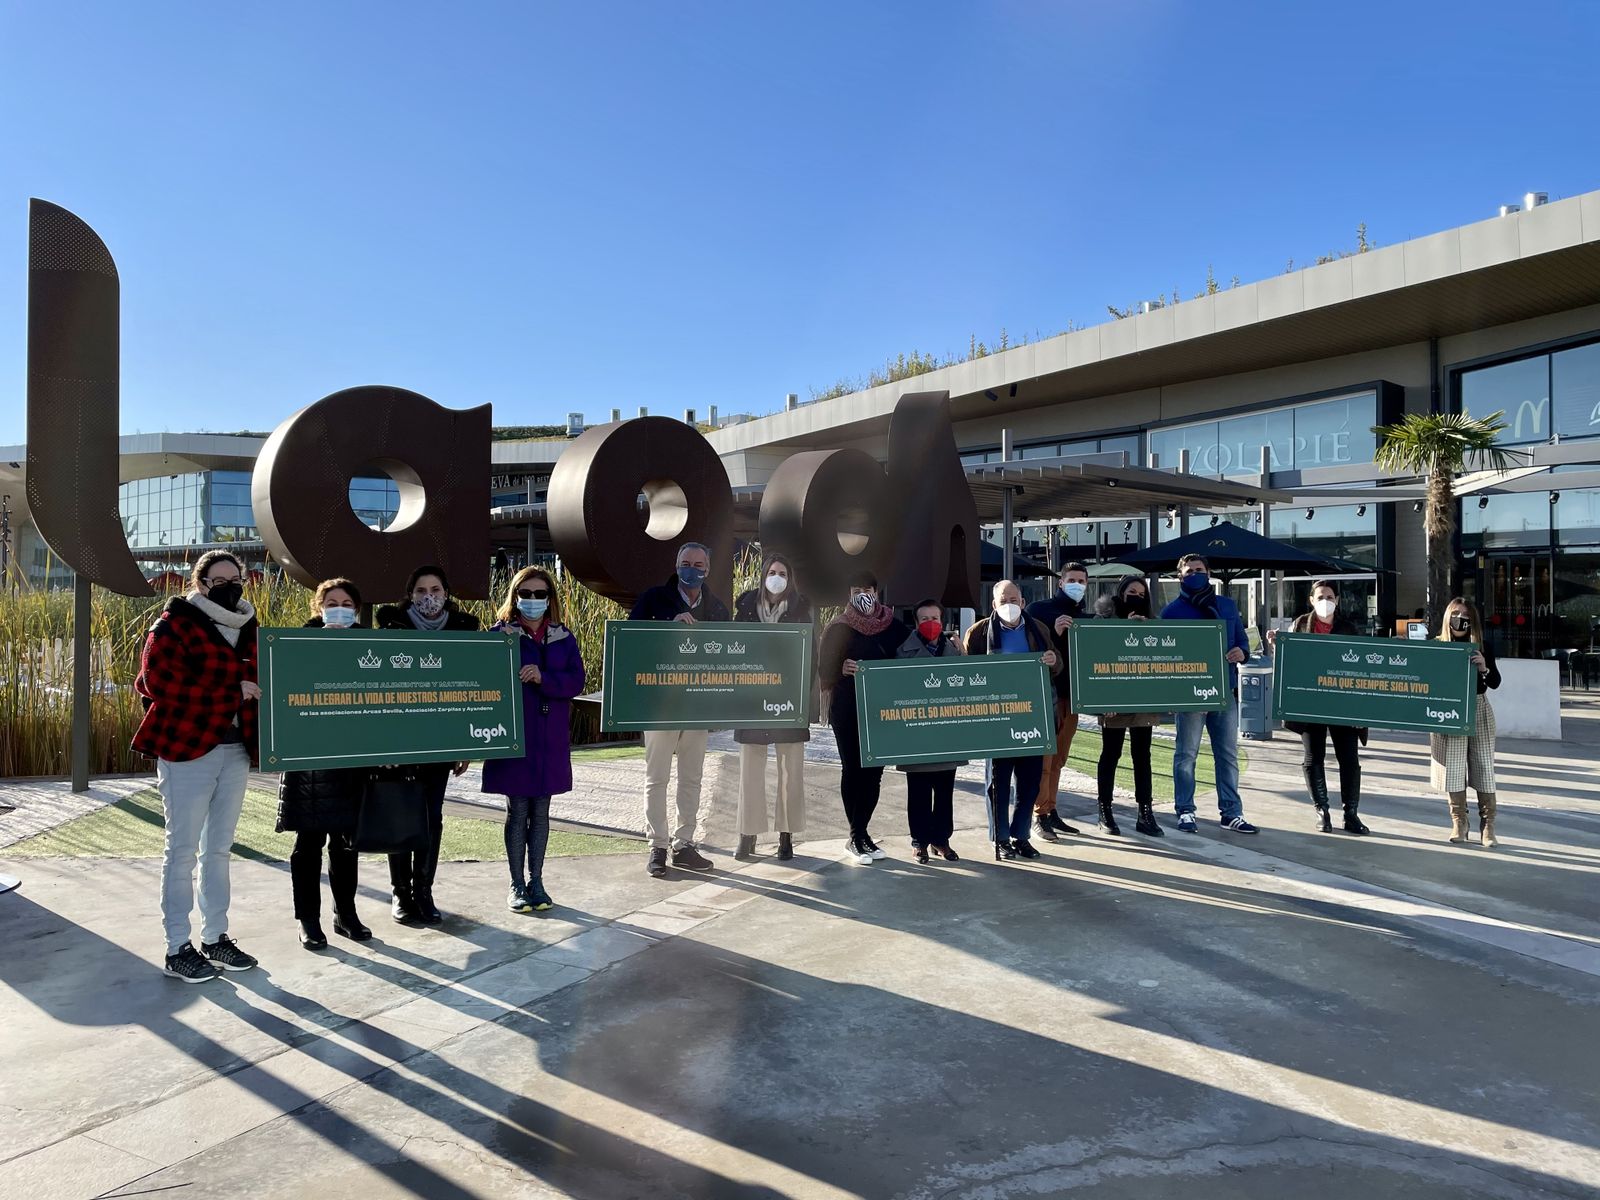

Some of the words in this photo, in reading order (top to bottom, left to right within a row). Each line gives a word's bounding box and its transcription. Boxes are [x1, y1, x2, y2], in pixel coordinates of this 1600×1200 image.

[1179, 420, 1352, 474] VOLAPIÉ
[1094, 663, 1110, 673] PARA
[1111, 663, 1128, 673] TODO
[1129, 663, 1136, 673] LO
[1138, 663, 1150, 675] QUE
[1151, 663, 1174, 673] PUEDAN
[1175, 663, 1207, 672] NECESITAR
[314, 681, 365, 689] DONACIÓN
[636, 673, 657, 685] PARA
[658, 673, 688, 685] LLENAR
[690, 673, 699, 685] LA
[701, 671, 733, 685] CÁMARA
[734, 671, 782, 684] FRIGORÍFICA
[1318, 676, 1337, 687] PARA
[1339, 678, 1354, 689] QUE
[1355, 678, 1389, 690] SIEMPRE
[1391, 681, 1408, 692] SIGA
[1410, 682, 1429, 694] VIVO
[288, 694, 311, 706] PARA
[313, 693, 352, 706] ALEGRAR
[353, 693, 363, 704] LA
[365, 692, 384, 704] VIDA
[385, 692, 396, 704] DE
[397, 691, 437, 704] NUESTROS
[439, 691, 468, 702] AMIGOS
[469, 691, 501, 702] PELUDOS
[1194, 685, 1218, 700] lagoh
[763, 700, 794, 716] lagoh
[880, 709, 900, 721] PARA
[901, 708, 917, 721] QUE
[918, 707, 927, 719] EL
[928, 706, 938, 718] 50
[940, 704, 988, 718] ANIVERSARIO
[989, 703, 999, 714] NO
[1001, 701, 1032, 714] TERMINE
[1426, 707, 1460, 722] lagoh
[470, 724, 507, 743] lagoh
[1010, 727, 1041, 744] lagoh
